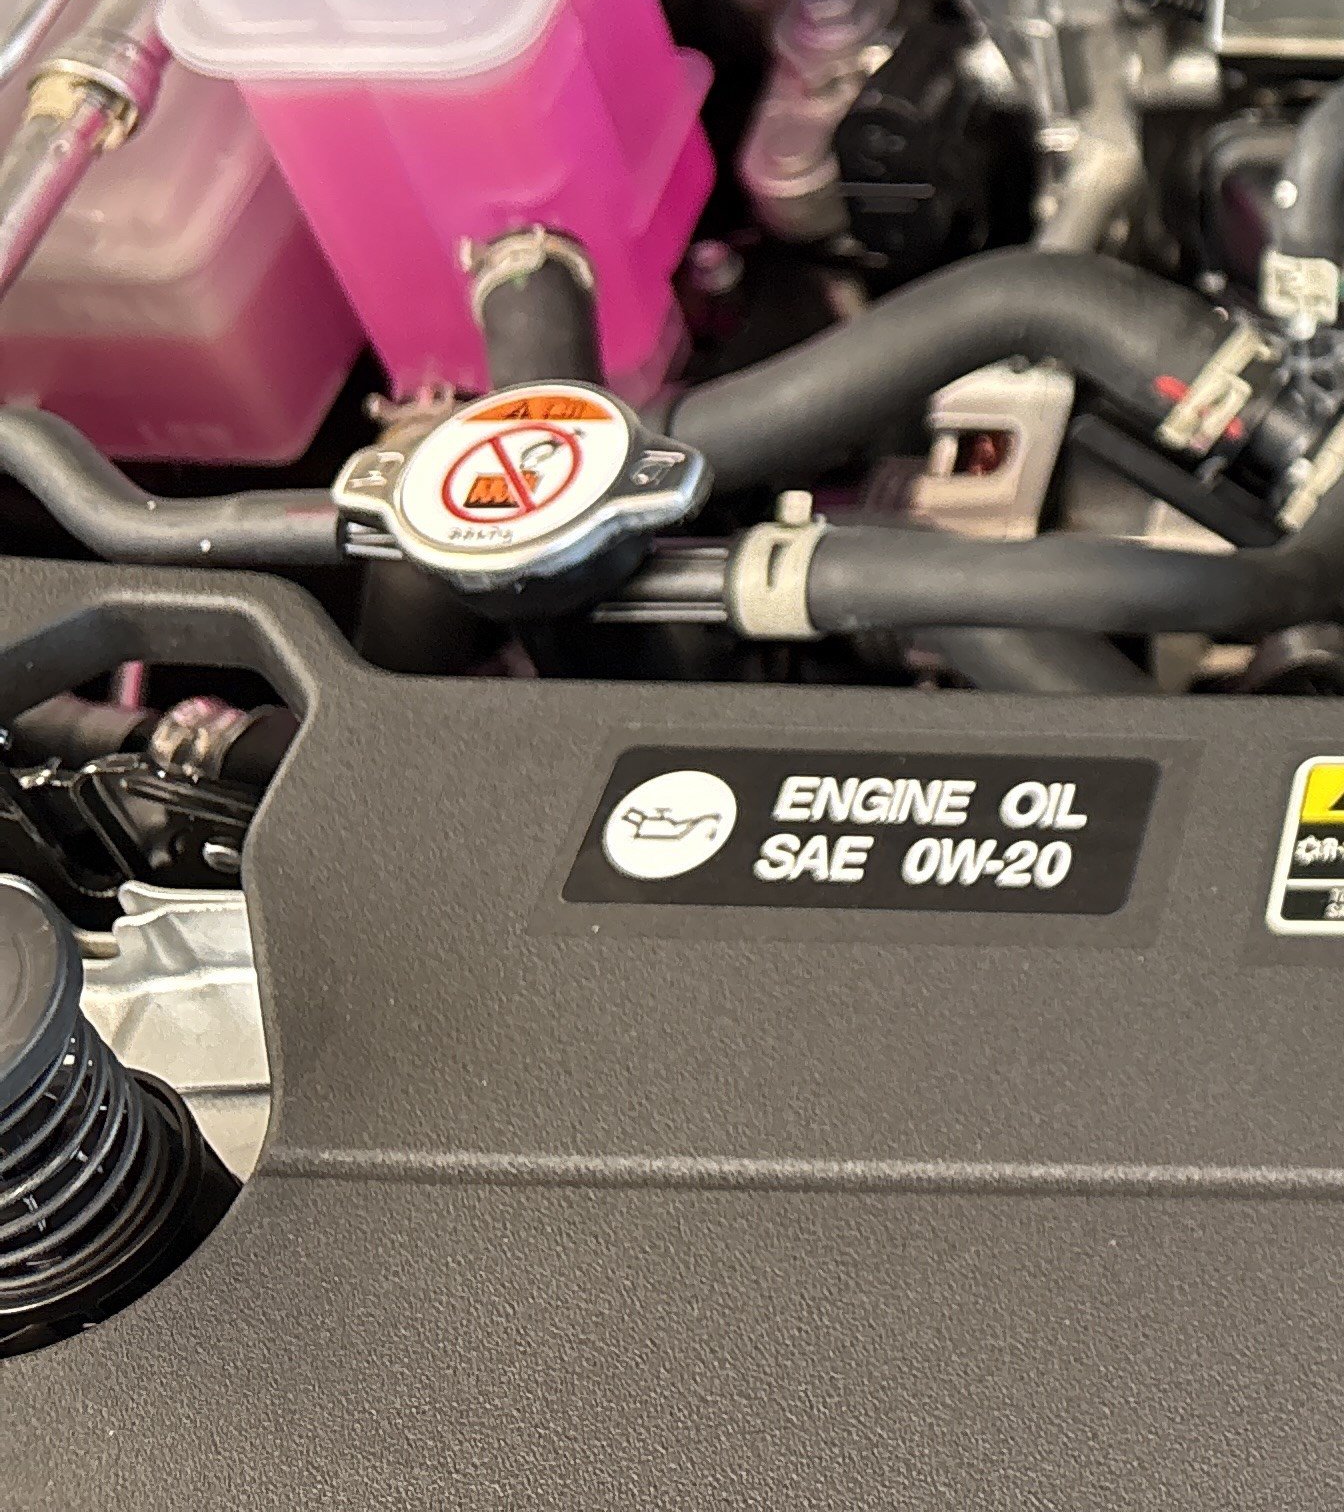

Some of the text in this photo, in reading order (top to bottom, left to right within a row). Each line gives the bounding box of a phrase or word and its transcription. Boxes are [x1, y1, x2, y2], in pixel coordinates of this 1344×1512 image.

[772, 775, 1088, 831] ENGINE OIL
[753, 834, 1072, 889] SAE 0W-20
